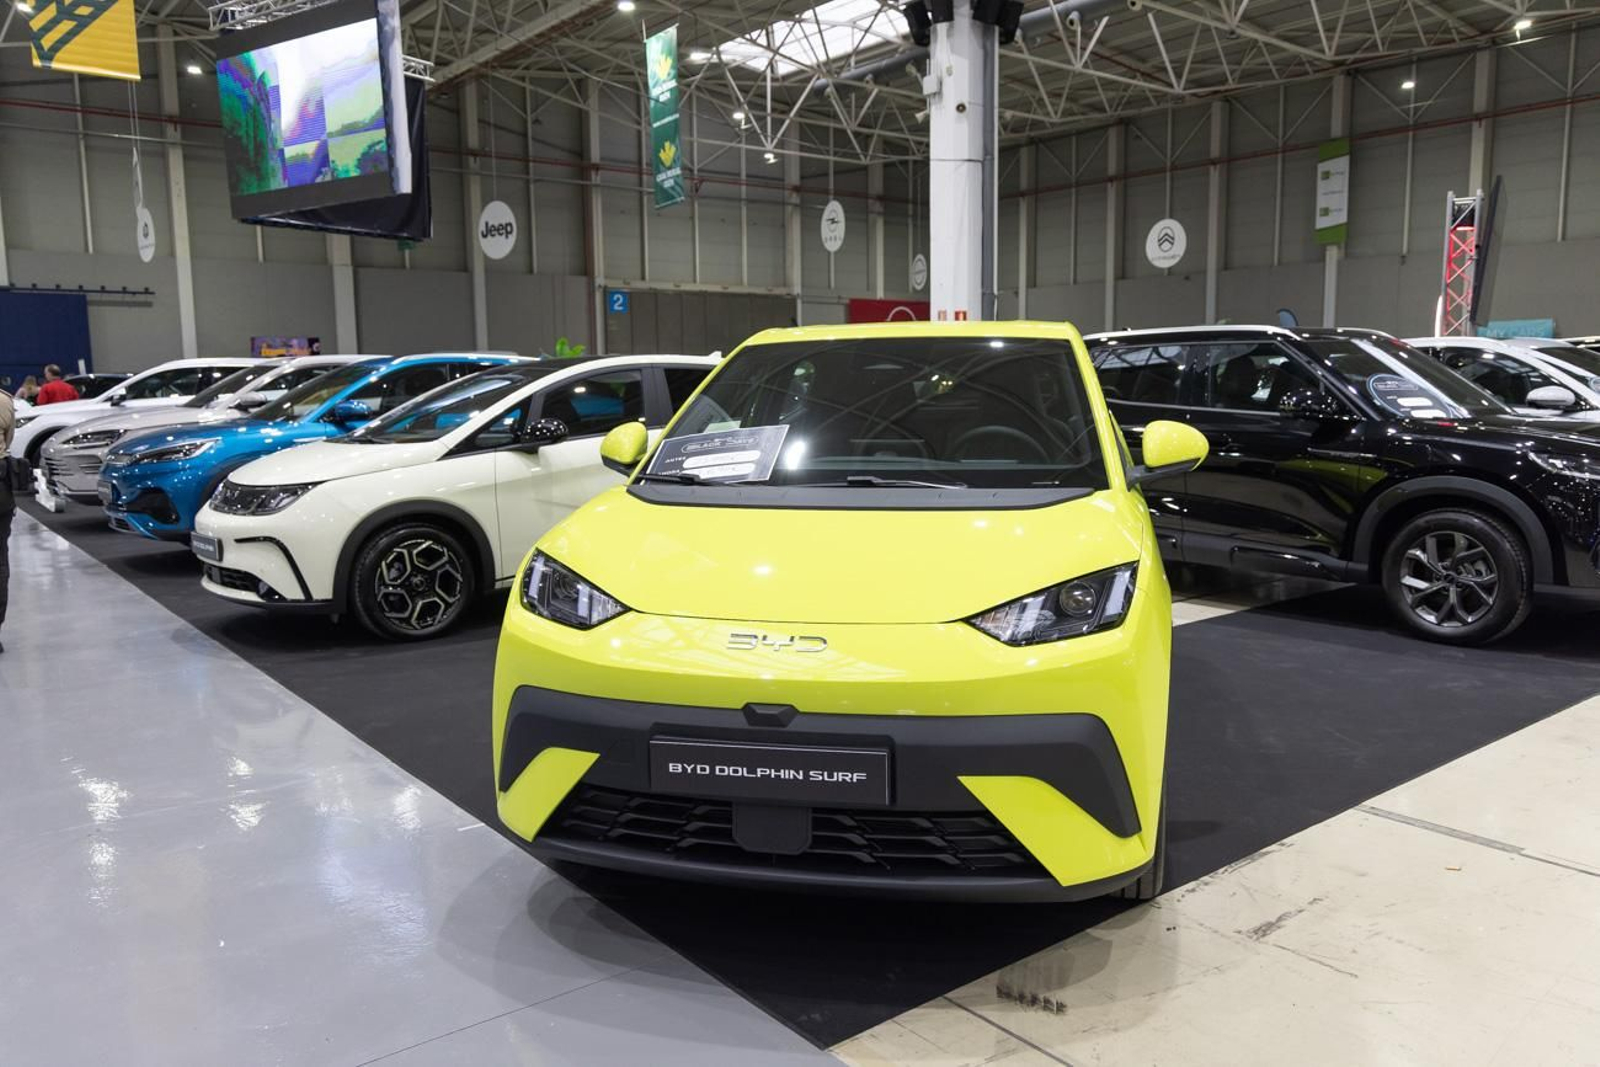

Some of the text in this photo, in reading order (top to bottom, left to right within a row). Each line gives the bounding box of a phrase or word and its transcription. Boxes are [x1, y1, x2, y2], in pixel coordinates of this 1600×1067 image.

[481, 221, 513, 239] Jeep
[613, 294, 624, 310] 2
[726, 633, 828, 653] BYD
[668, 762, 868, 783] BYD DOLPHIN SURF
